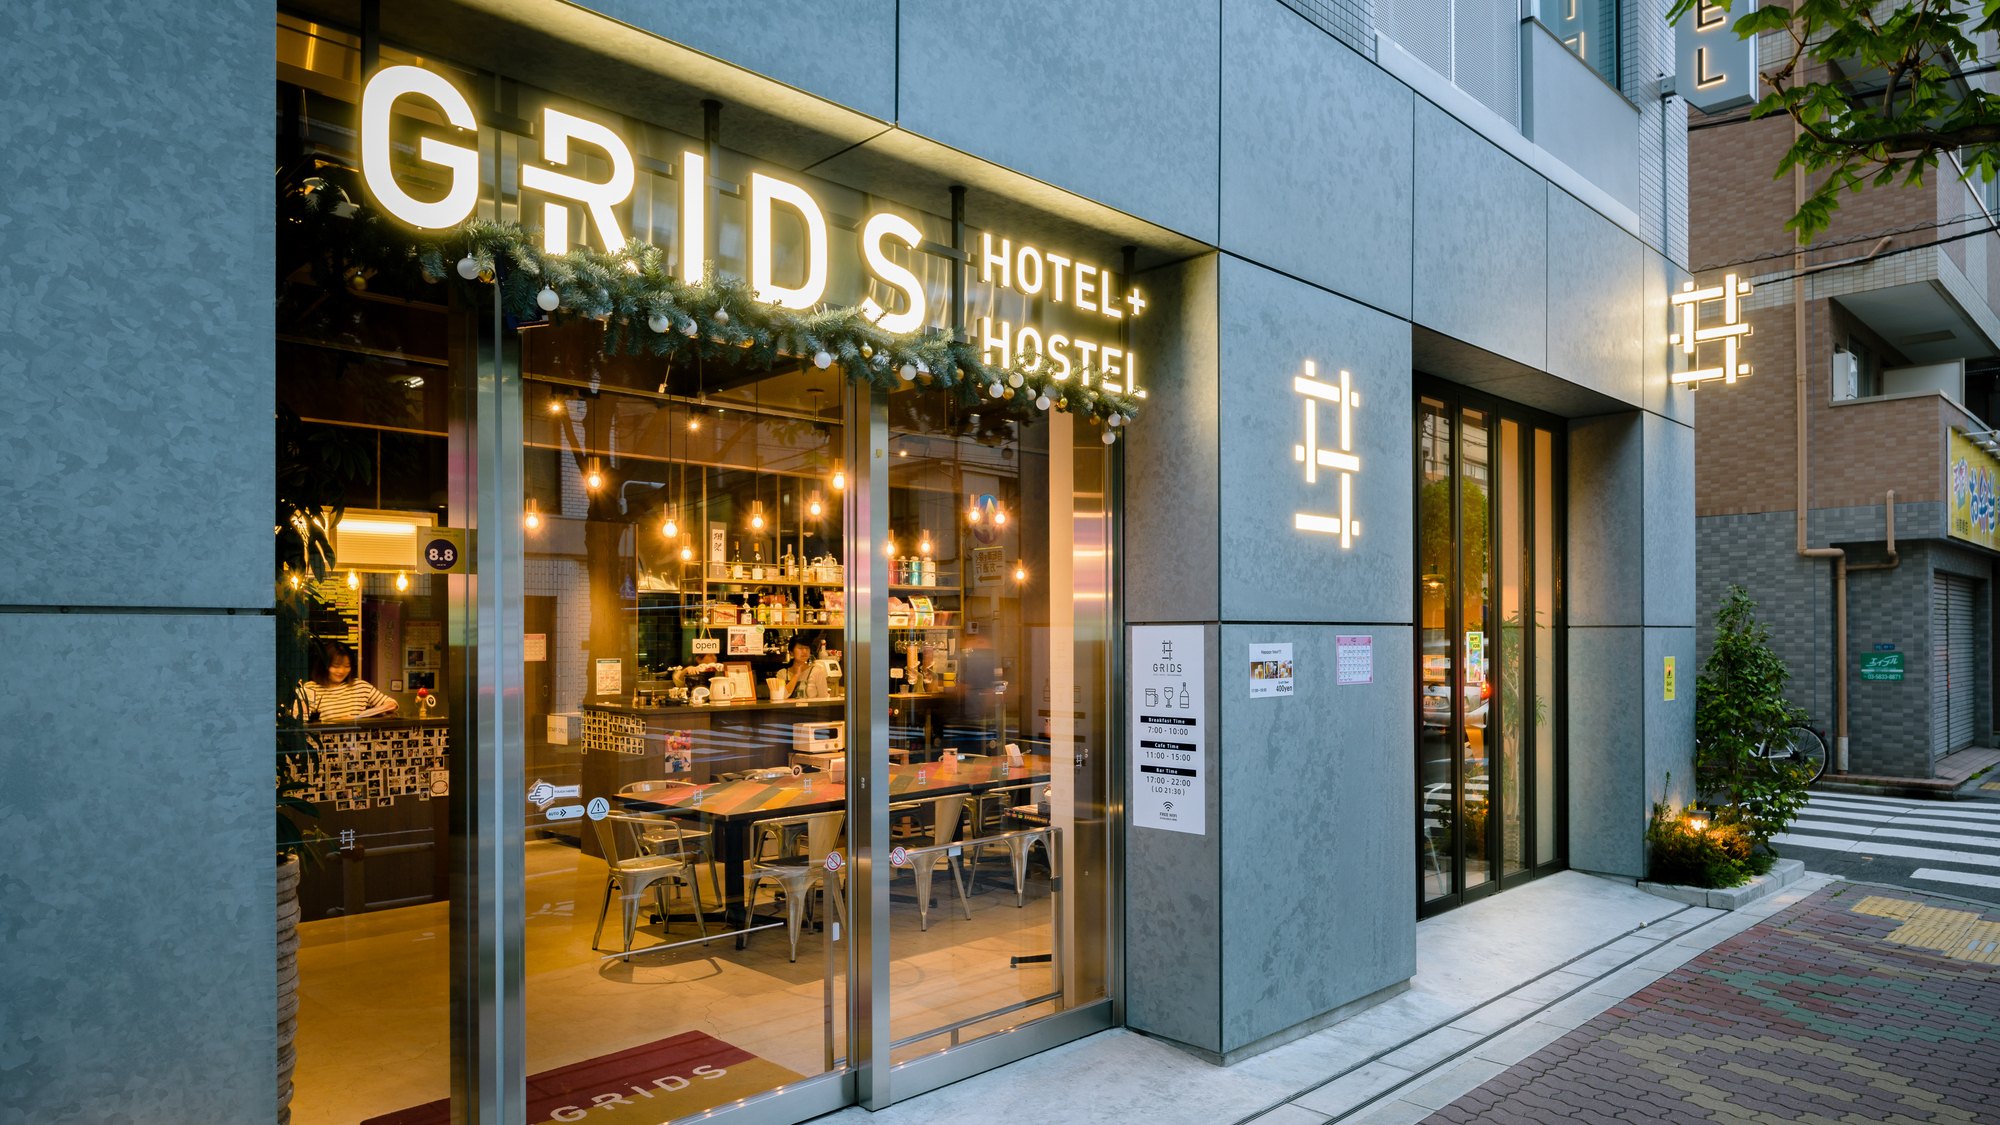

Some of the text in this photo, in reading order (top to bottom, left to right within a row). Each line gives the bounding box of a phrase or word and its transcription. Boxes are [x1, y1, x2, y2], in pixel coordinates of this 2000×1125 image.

[360, 64, 925, 334] GRIDS
[982, 317, 1147, 399] HOSTEL
[429, 548, 454, 561] 8.8
[695, 642, 717, 651] open
[1152, 663, 1183, 673] GRIDS
[1148, 726, 1163, 734] 7:00
[1169, 727, 1188, 735] 10:00
[1146, 752, 1164, 760] 11:00
[1171, 753, 1191, 762] 15:00
[1146, 776, 1165, 785] 17:00
[1171, 778, 1191, 787] 22:00
[1164, 787, 1181, 796] 21:30
[549, 1064, 727, 1123] GRIDS
